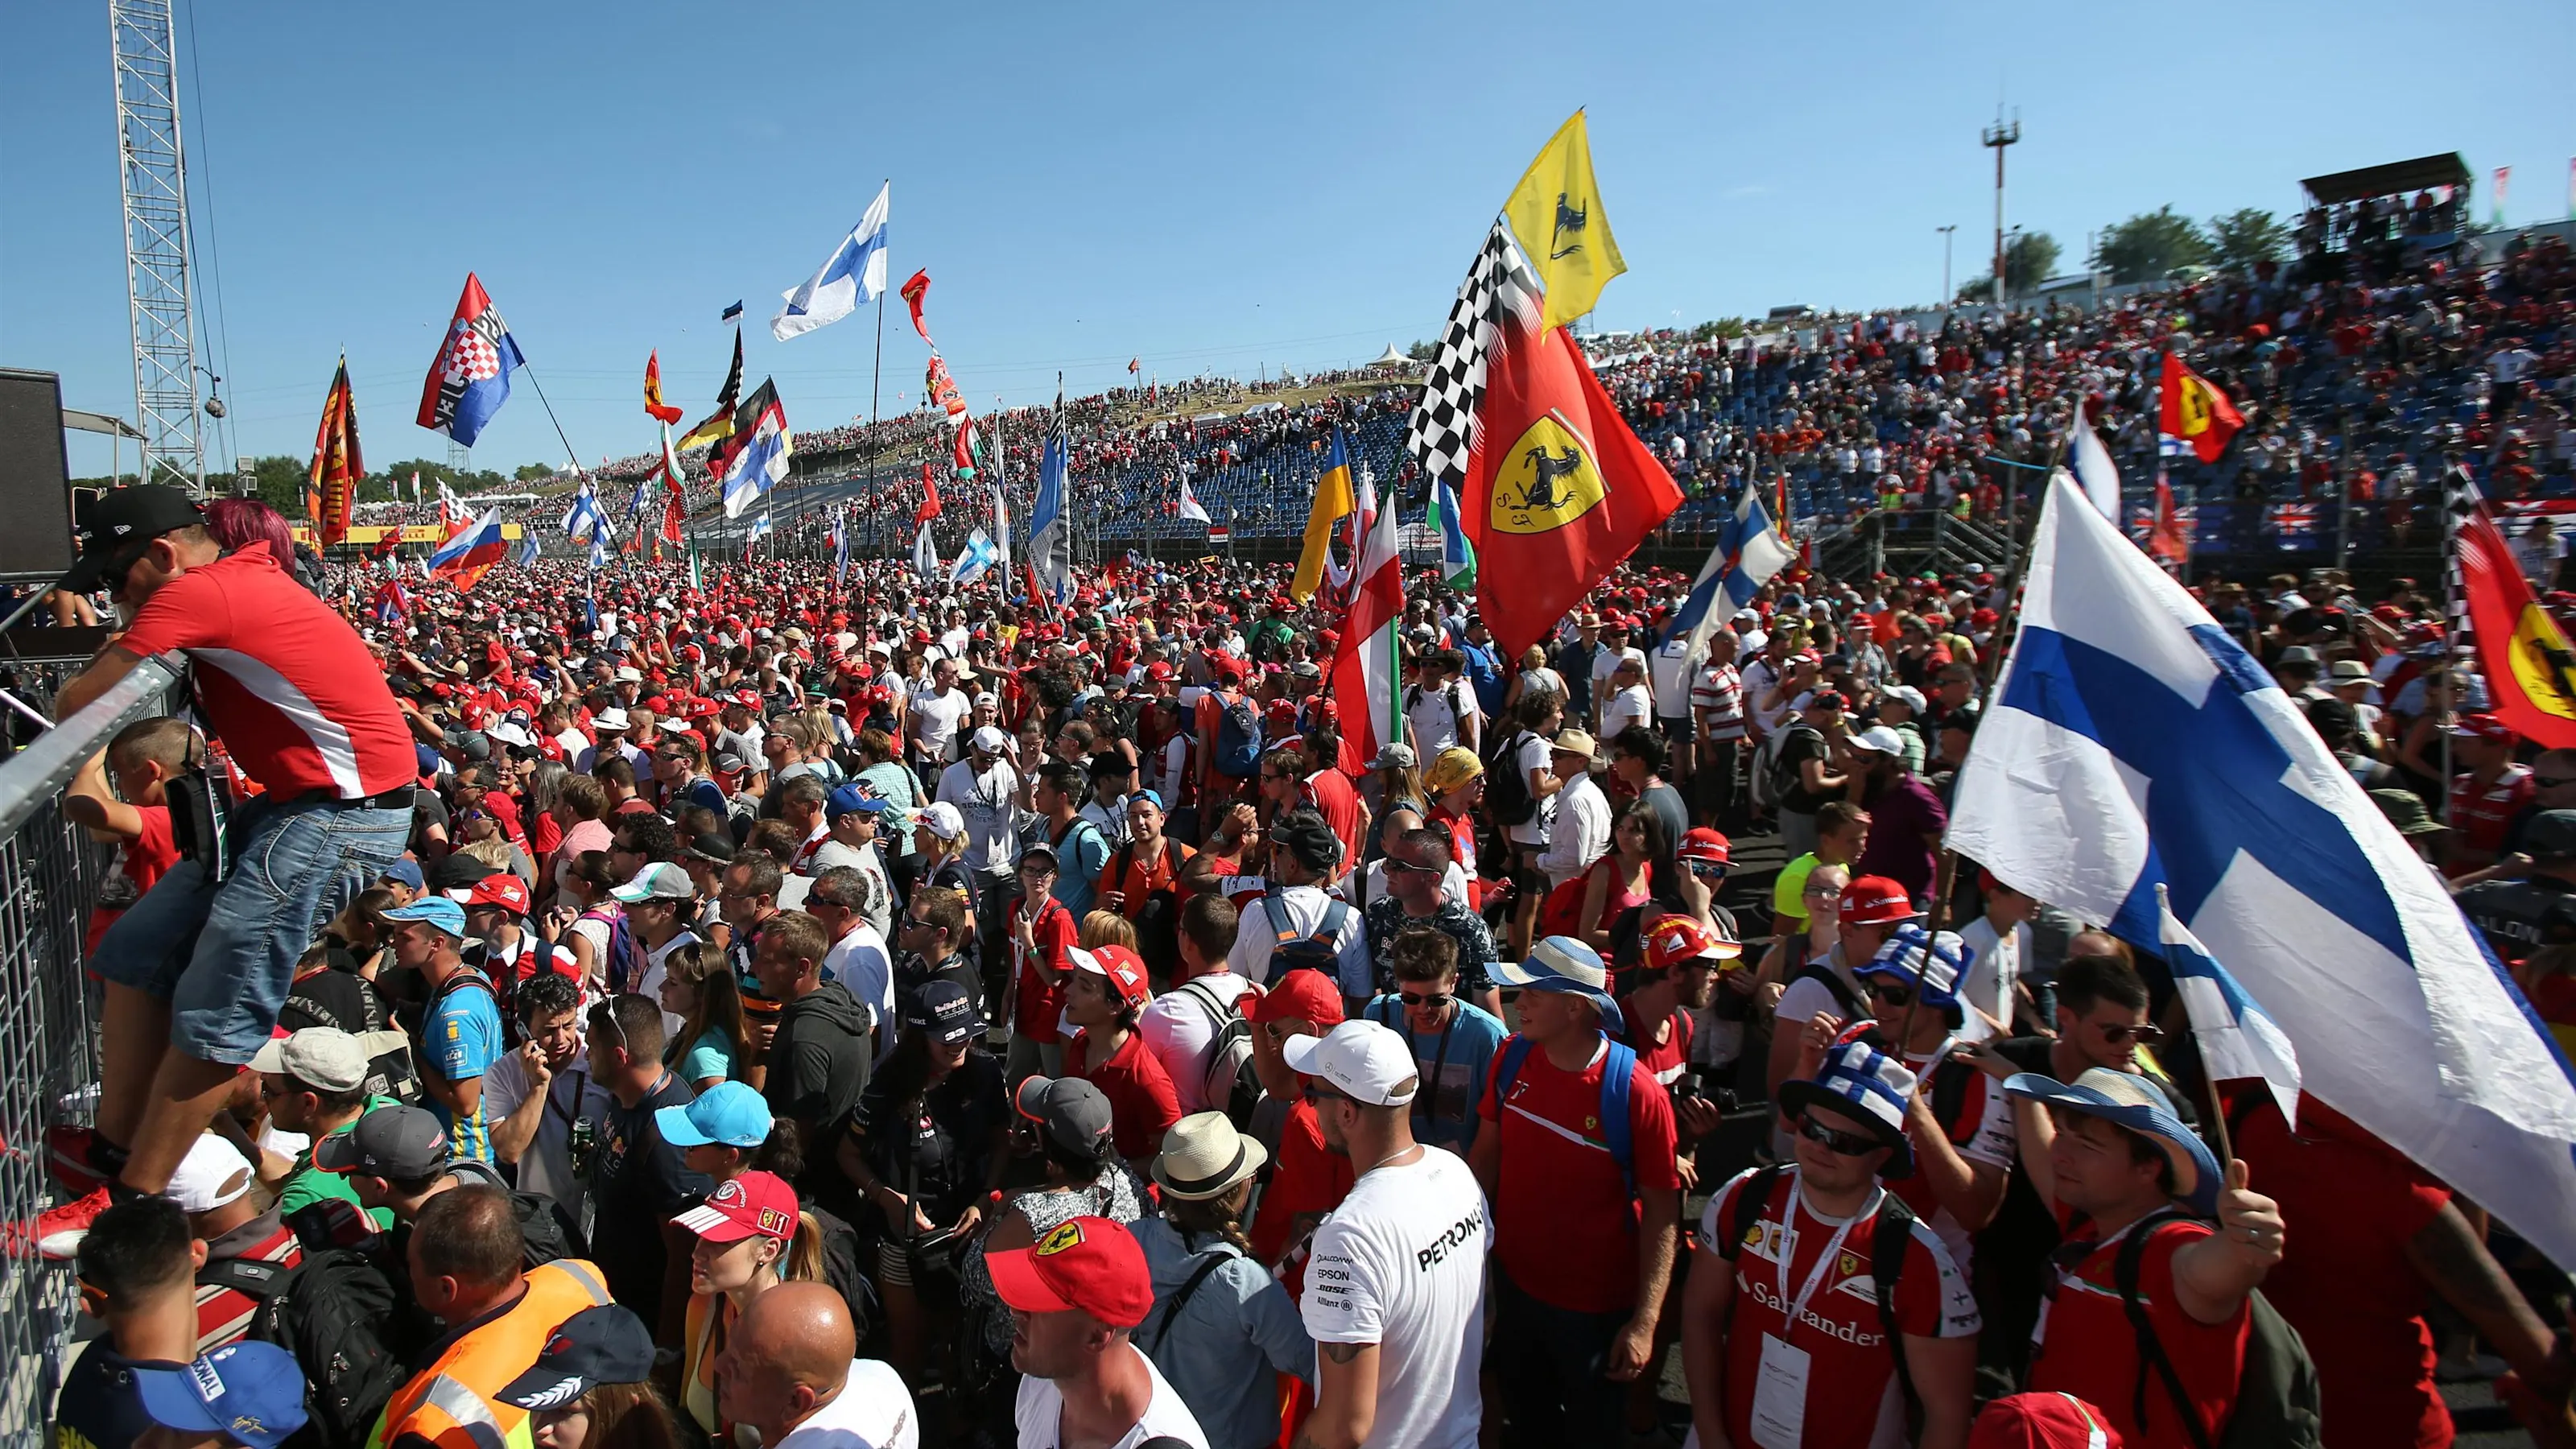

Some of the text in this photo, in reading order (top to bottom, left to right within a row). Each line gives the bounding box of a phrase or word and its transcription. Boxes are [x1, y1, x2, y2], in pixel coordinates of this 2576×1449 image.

[944, 1027, 967, 1042] 33
[1318, 1269, 1350, 1281] EPSON
[1316, 1285, 1355, 1294] BOSE
[1318, 1296, 1340, 1308] Allianz
